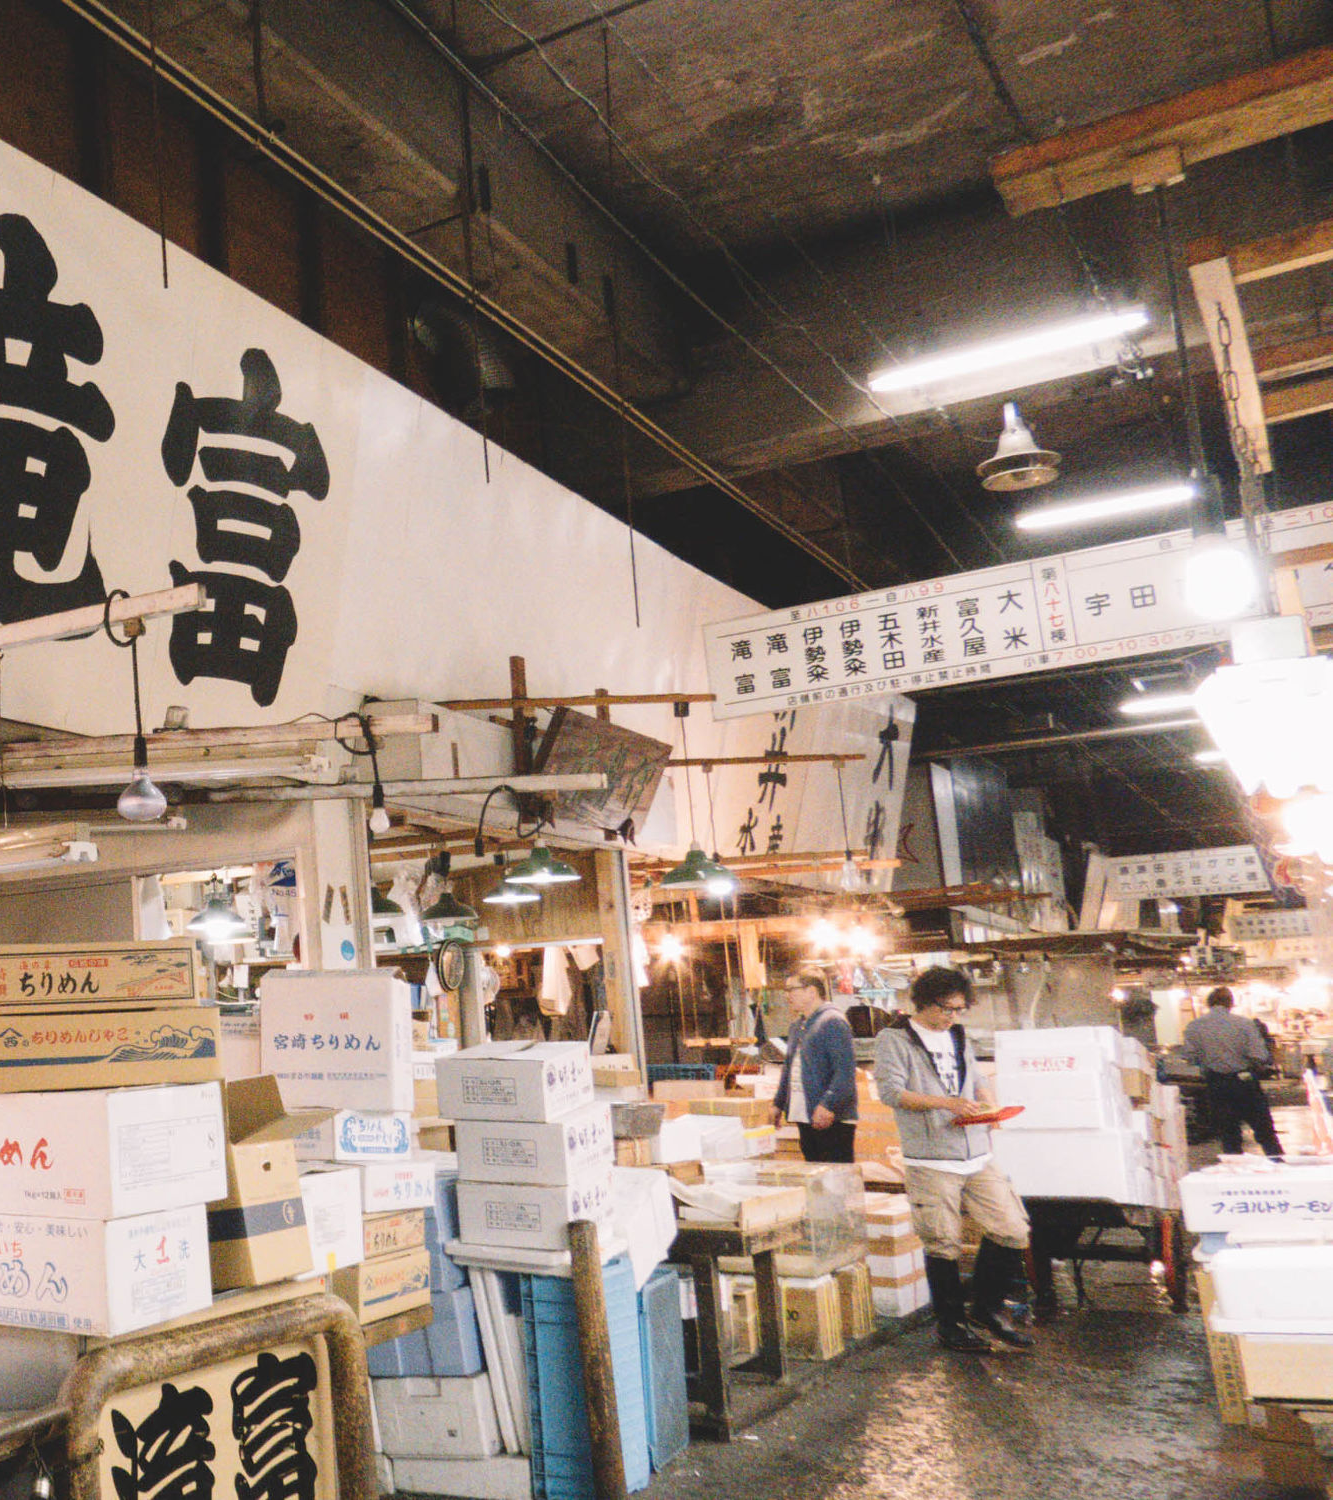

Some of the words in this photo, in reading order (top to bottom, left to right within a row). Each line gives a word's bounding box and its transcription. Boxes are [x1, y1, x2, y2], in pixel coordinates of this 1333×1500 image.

[877, 612, 906, 670] 五木田
[916, 605, 946, 664] 新井水産
[956, 597, 988, 657] 富久屋
[730, 640, 756, 695] 滝富
[766, 633, 792, 689] 滝富
[19, 971, 100, 997] ちりめん
[273, 1033, 381, 1052] 宮崎ちりめん
